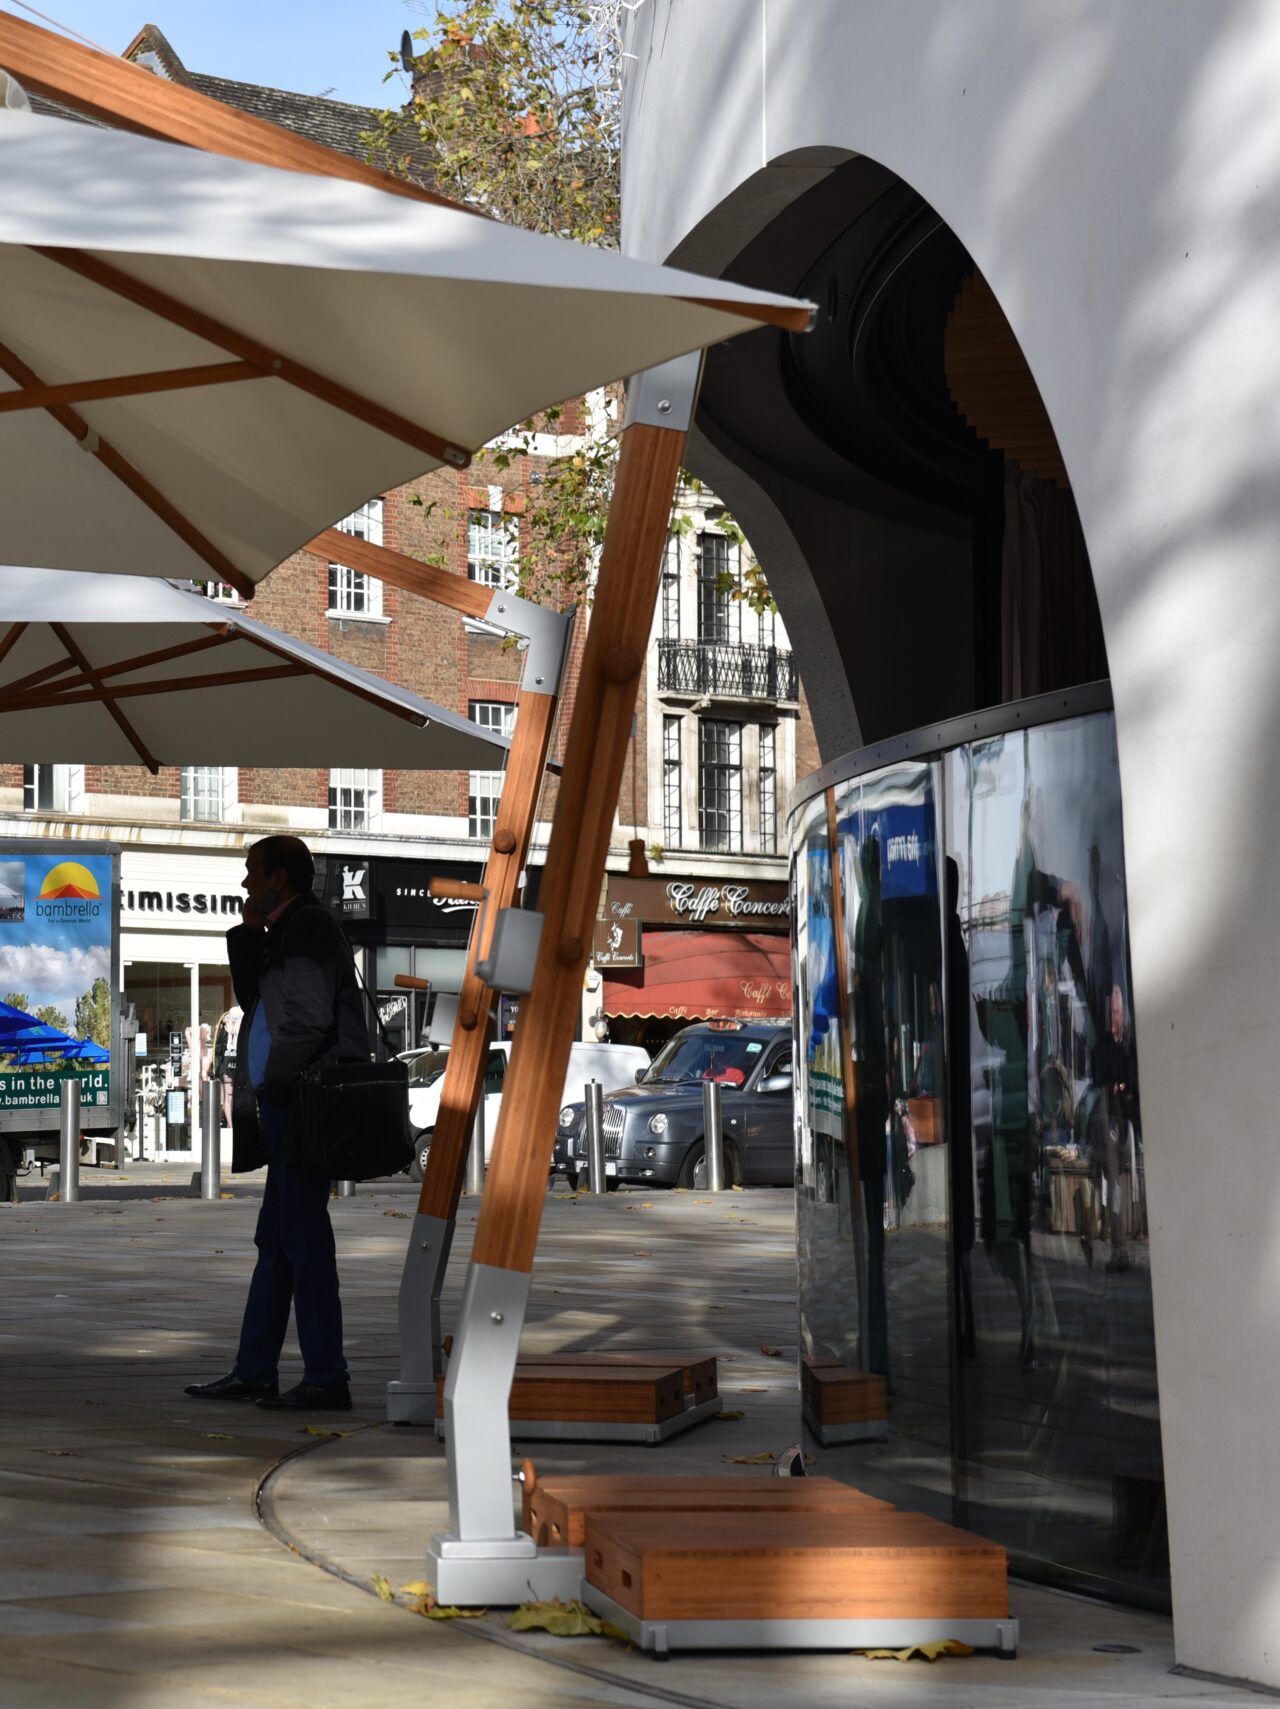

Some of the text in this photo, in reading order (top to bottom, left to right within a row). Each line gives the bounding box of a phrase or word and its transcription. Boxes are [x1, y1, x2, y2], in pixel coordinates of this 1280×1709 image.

[36, 901, 101, 916] bambrella
[11, 1076, 25, 1091] in
[30, 1075, 55, 1090] the
[60, 1073, 109, 1089] rld.
